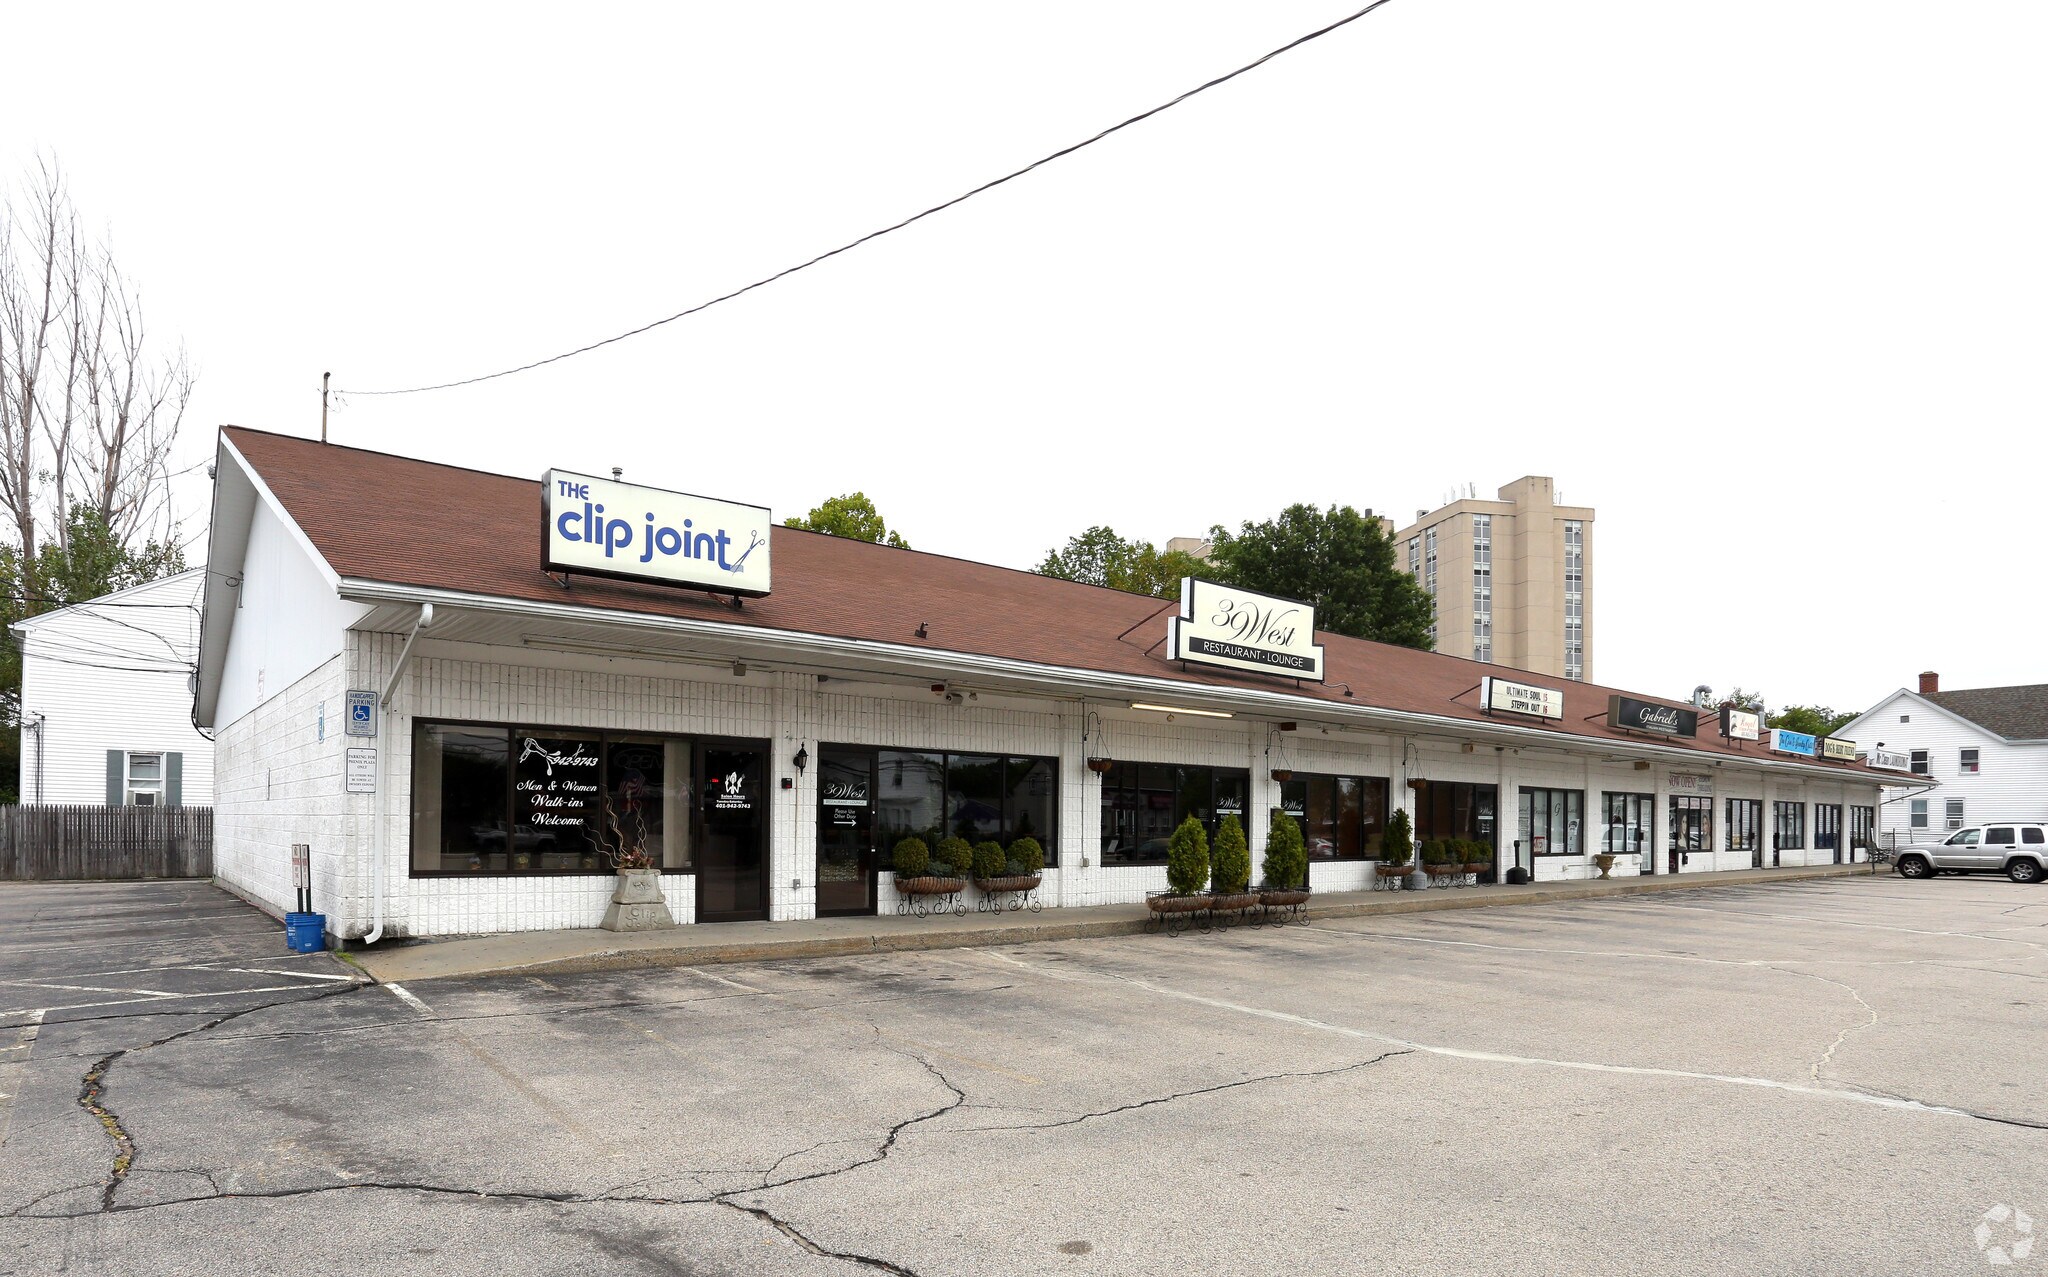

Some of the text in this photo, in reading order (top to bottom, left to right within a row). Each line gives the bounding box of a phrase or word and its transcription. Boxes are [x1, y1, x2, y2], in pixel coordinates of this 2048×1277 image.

[557, 480, 589, 500] THE
[557, 502, 733, 573] clip joint
[1203, 641, 1304, 668] RESTAURANT LOUNGE
[1506, 686, 1528, 698] ULTIMATE
[1529, 690, 1541, 701] SOUL
[1511, 700, 1529, 711] STEPPIN
[1530, 703, 1540, 713] OUT
[1639, 707, 1679, 725] Gabriel's
[1825, 742, 1835, 753] DOG'S
[553, 756, 599, 767] 942-9743
[516, 779, 598, 792] Men & Women
[530, 793, 584, 807] Walk-ins
[531, 812, 585, 826] Welcome
